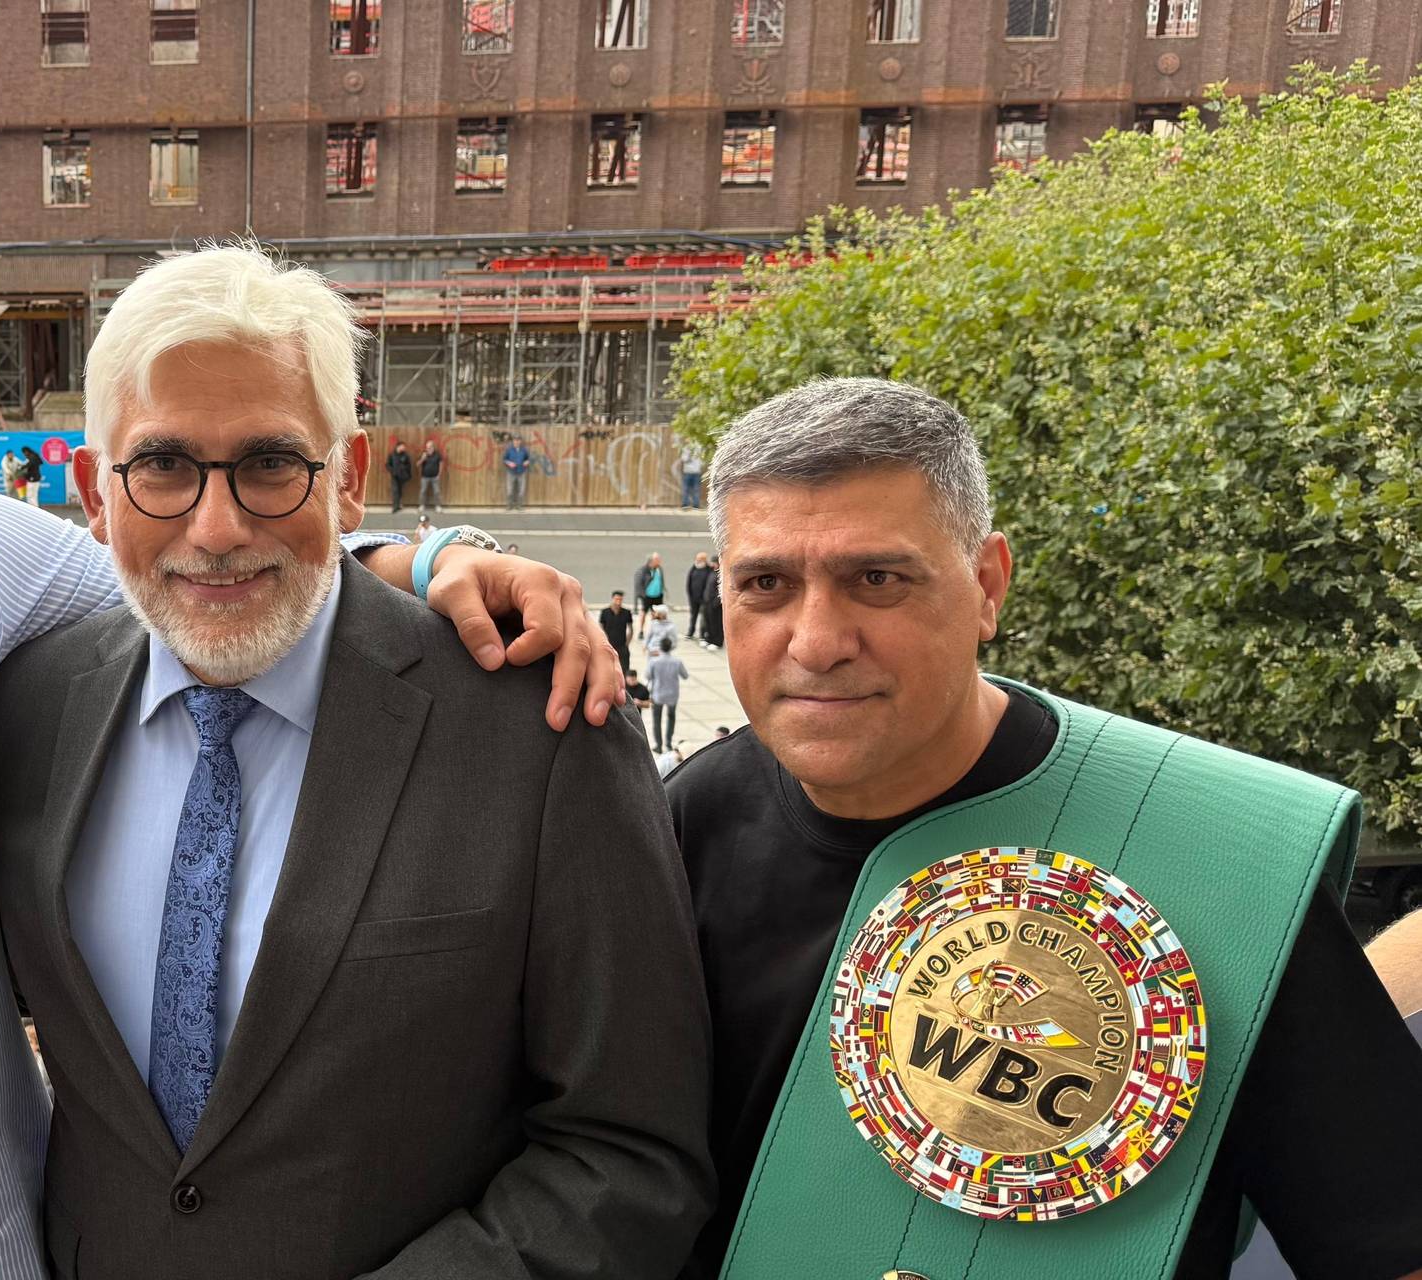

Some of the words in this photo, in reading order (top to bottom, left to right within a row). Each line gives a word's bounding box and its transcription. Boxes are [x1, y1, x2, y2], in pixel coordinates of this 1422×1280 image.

[908, 921, 1010, 999] WORLD
[1018, 922, 1127, 1074] CHAMPION
[908, 1015, 1096, 1129] WBC
